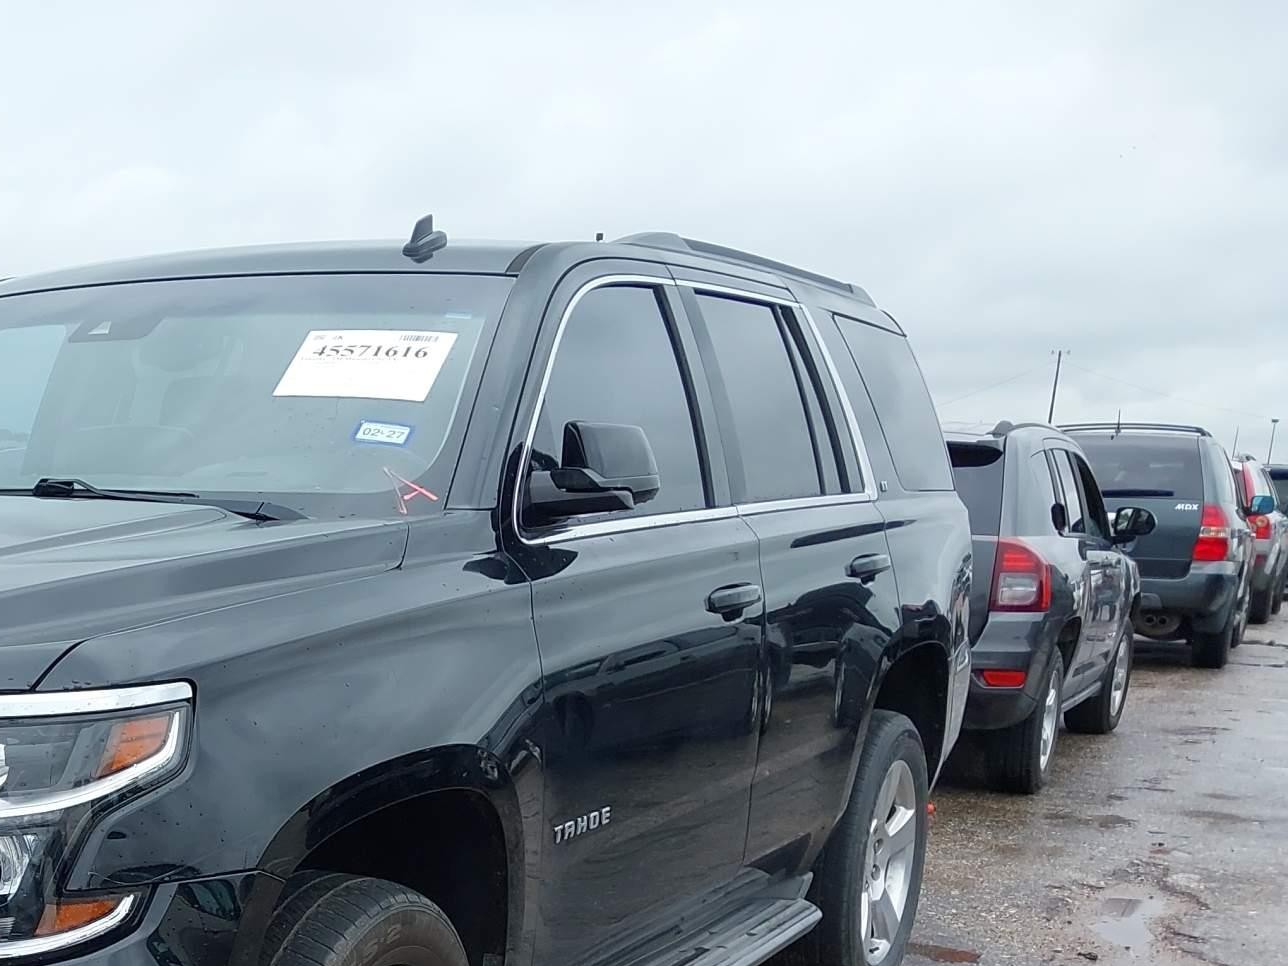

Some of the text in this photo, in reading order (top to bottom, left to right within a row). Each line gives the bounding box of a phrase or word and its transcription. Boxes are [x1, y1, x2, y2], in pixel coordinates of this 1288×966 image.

[313, 344, 430, 359] 45571616
[1174, 503, 1200, 511] MDX
[553, 806, 612, 844] TAHOE
